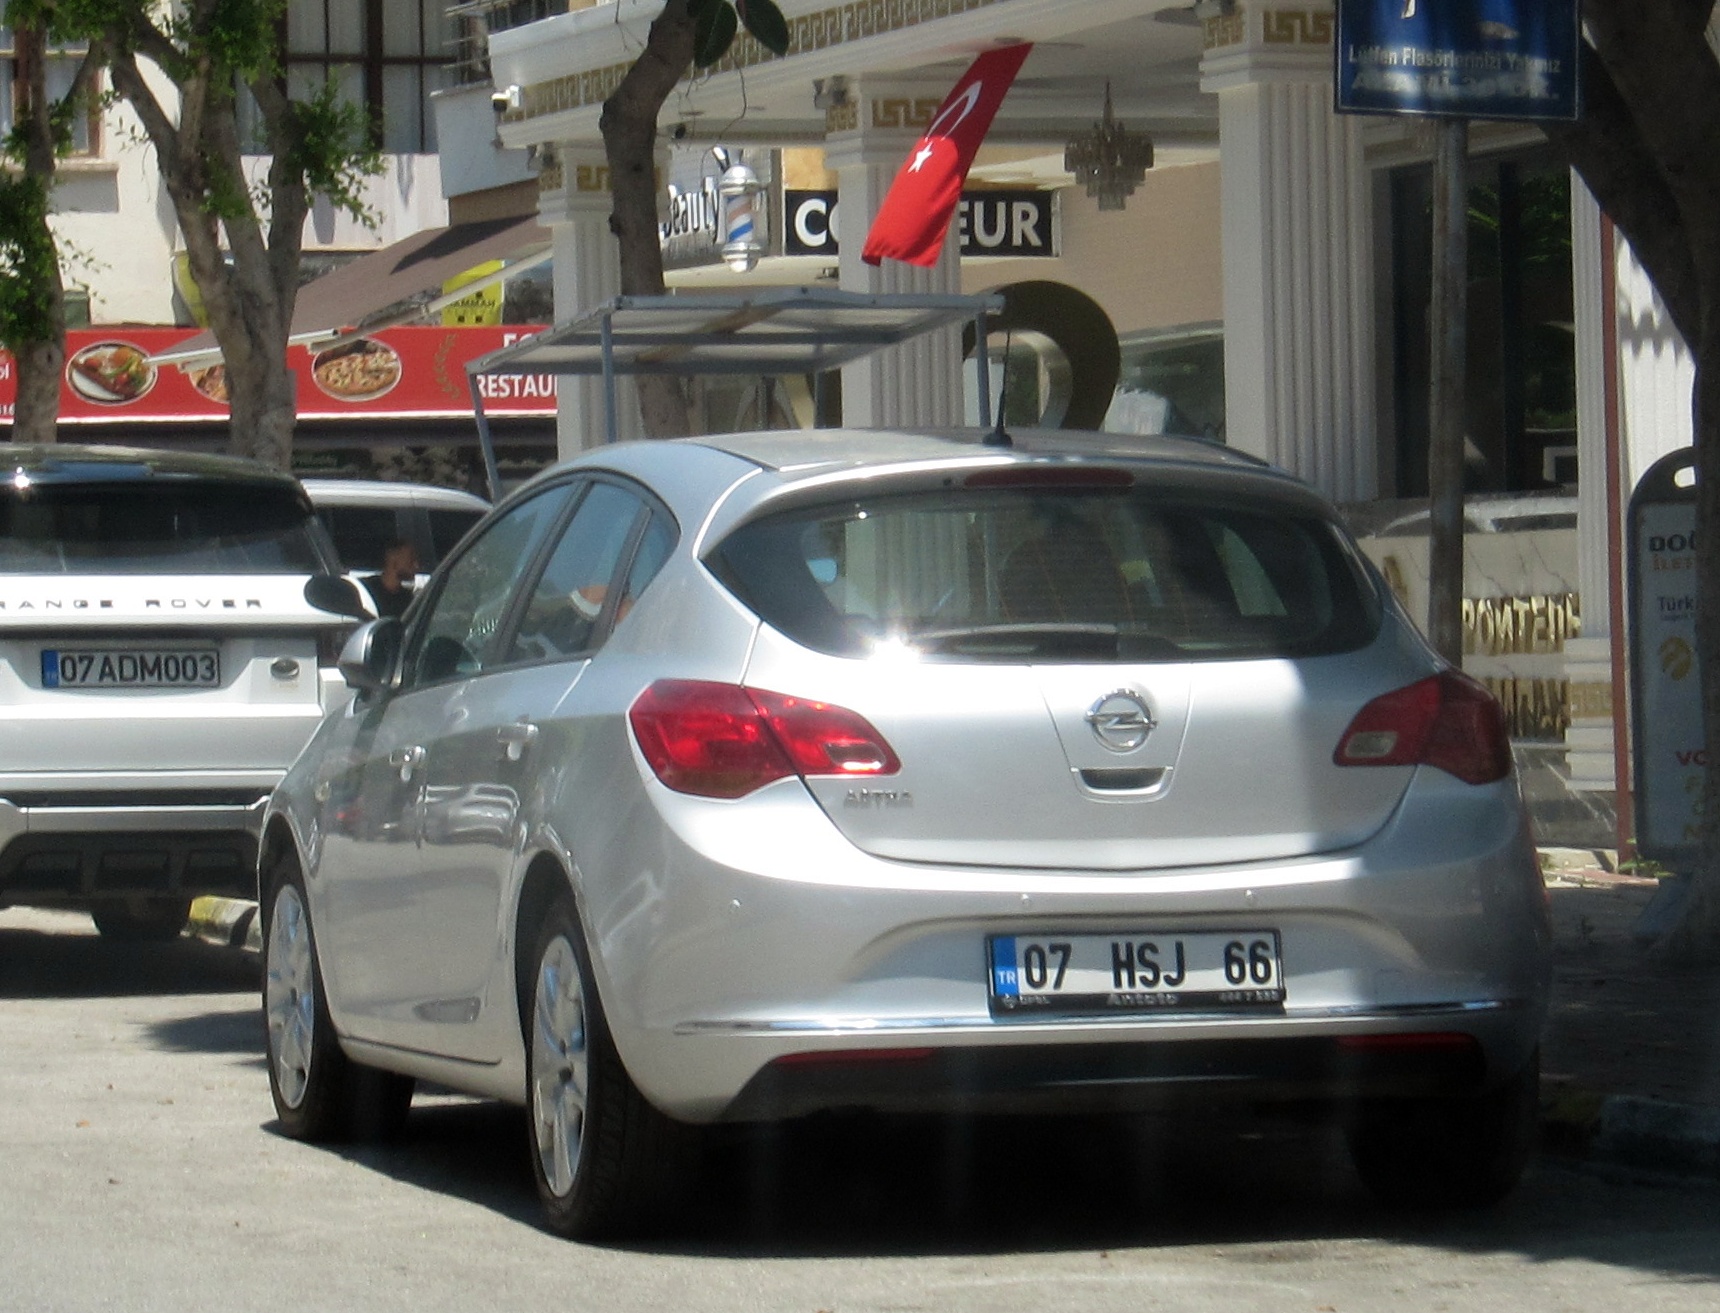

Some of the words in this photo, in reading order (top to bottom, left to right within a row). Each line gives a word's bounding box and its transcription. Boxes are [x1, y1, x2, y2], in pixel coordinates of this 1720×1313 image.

[146, 599, 263, 609] ROVER
[1024, 943, 1072, 990] 07
[1111, 941, 1186, 989] HSJ
[1225, 939, 1272, 985] 66
[998, 970, 1016, 985] TR
